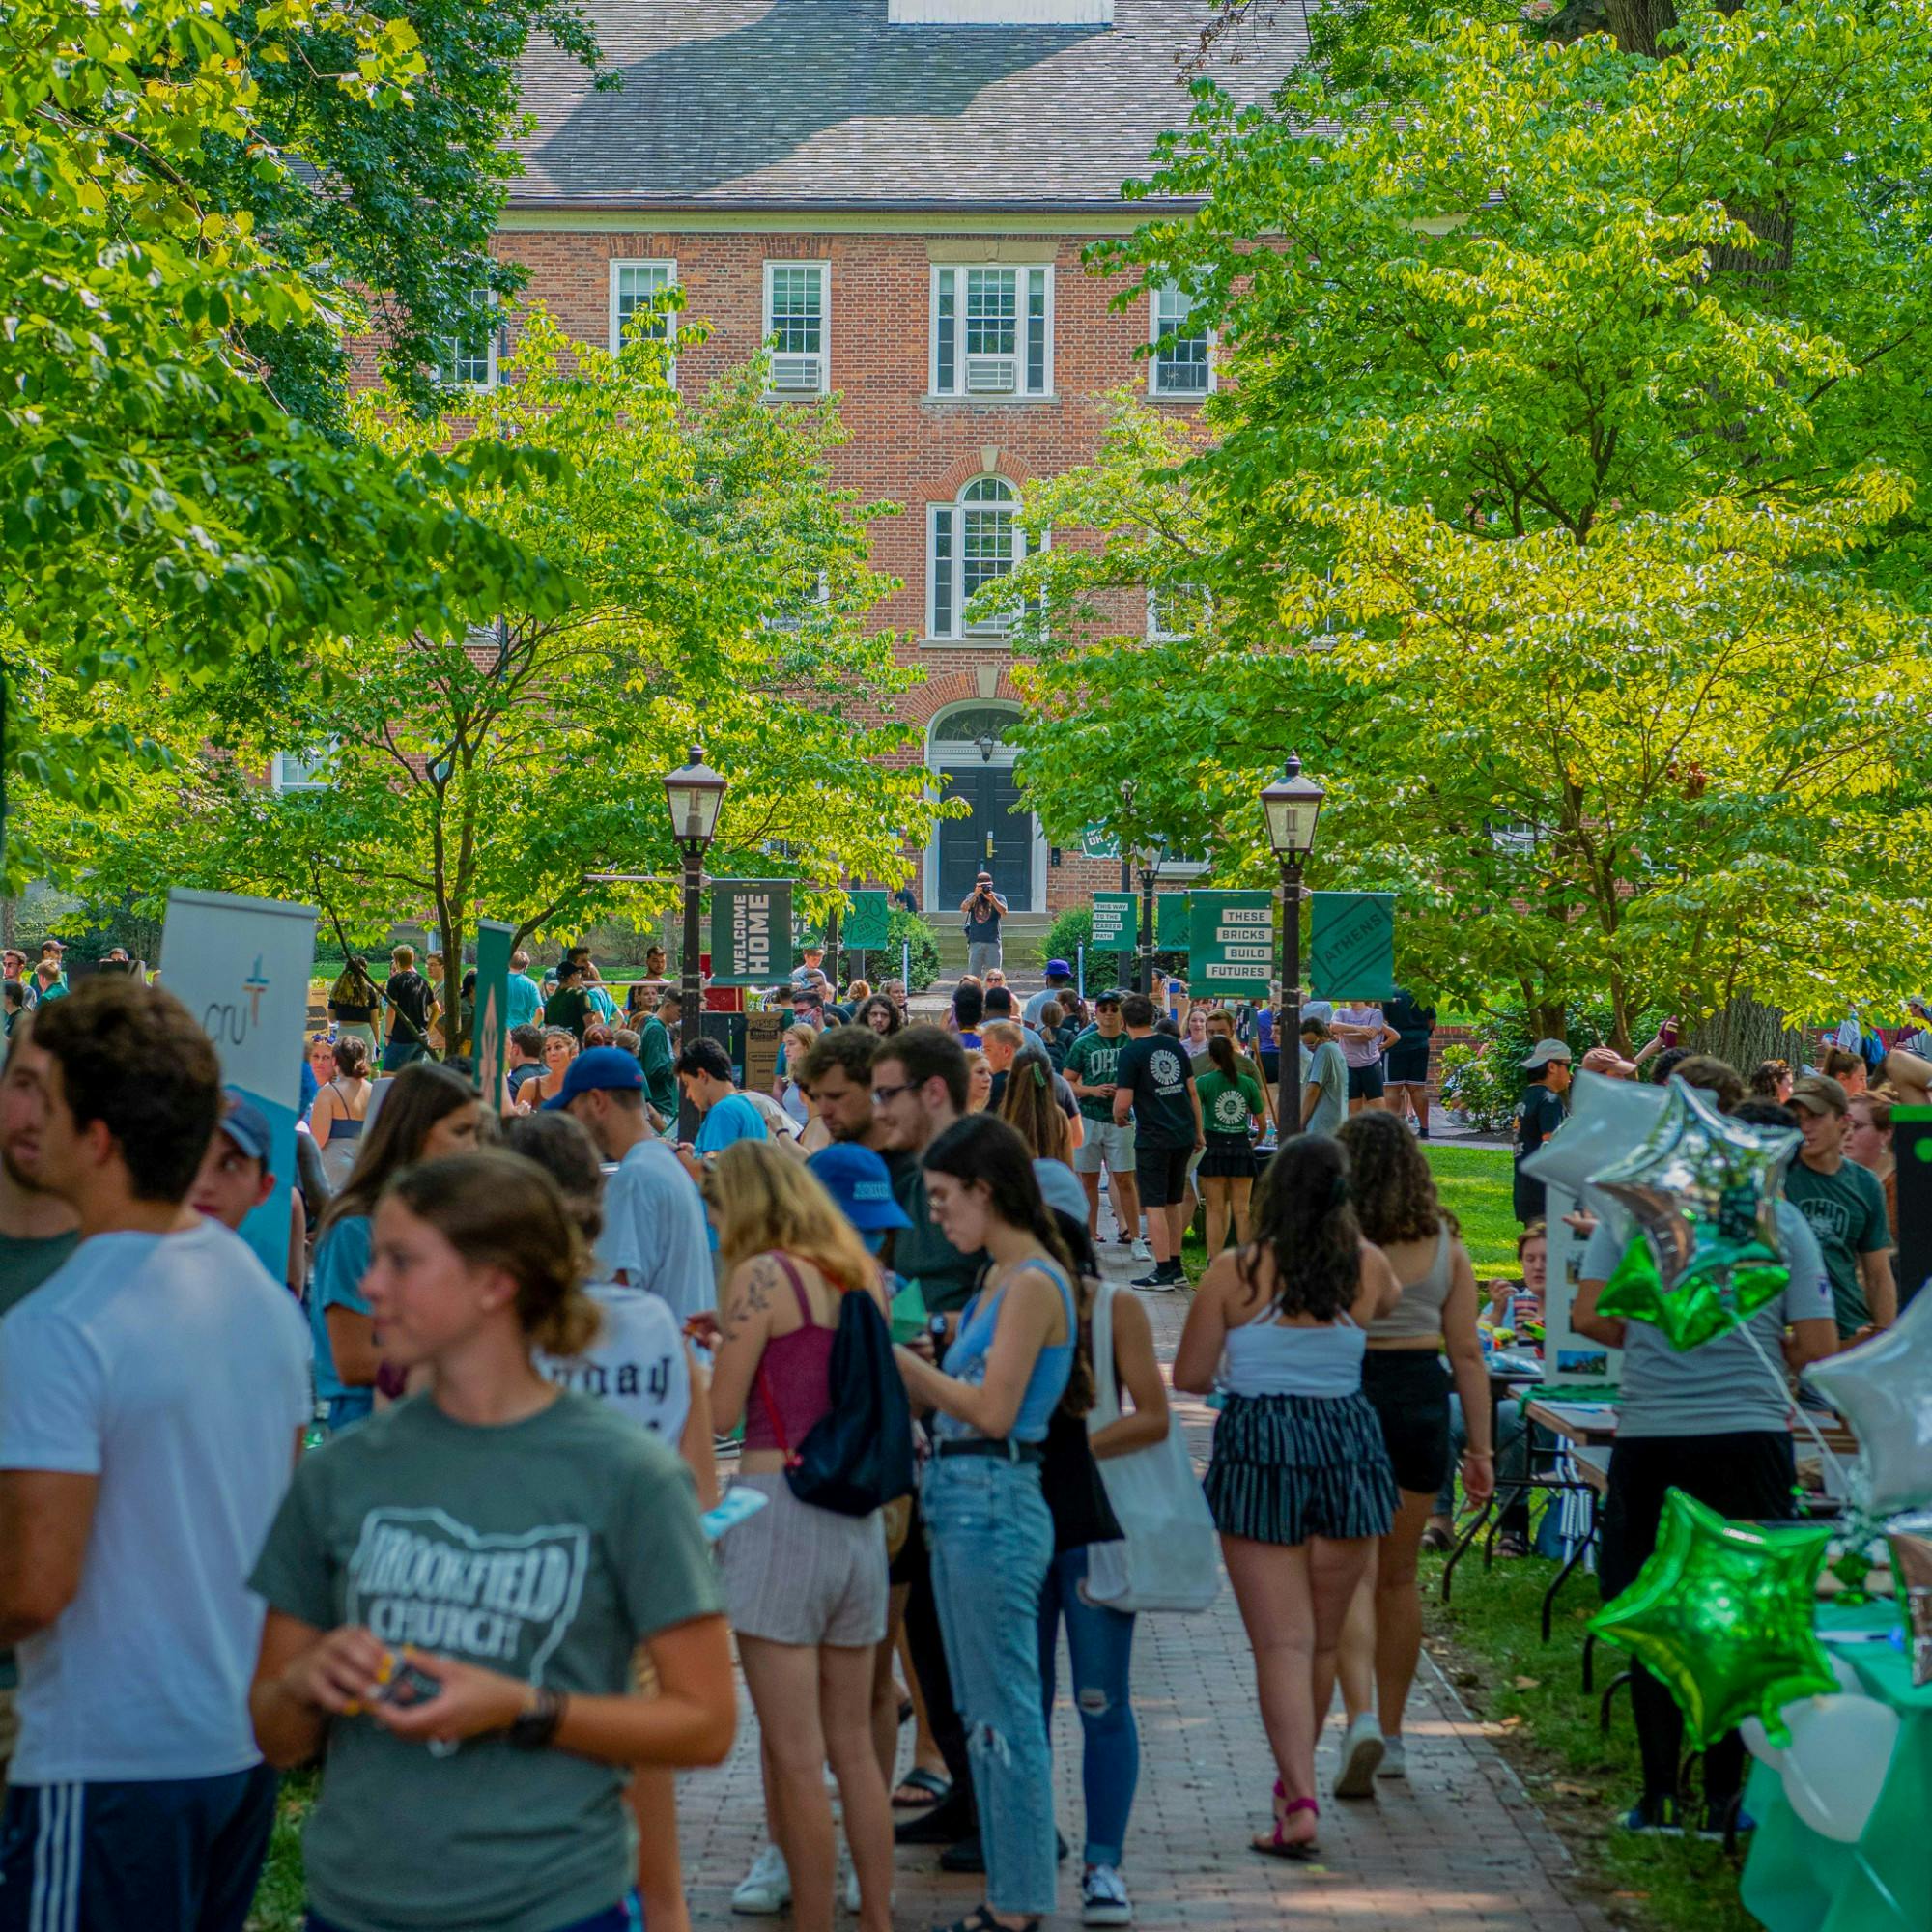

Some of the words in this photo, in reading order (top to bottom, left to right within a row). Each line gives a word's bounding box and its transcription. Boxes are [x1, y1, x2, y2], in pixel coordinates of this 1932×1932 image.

[733, 895, 746, 975] WELCOME
[748, 894, 769, 974] HOME
[1222, 930, 1265, 940] BRICKS
[1228, 912, 1265, 921] THESE
[1231, 949, 1264, 958] BUILD
[1325, 913, 1383, 964] ATHENS
[1211, 967, 1264, 977] FUTURES
[203, 1003, 248, 1045] cru
[369, 1597, 524, 1663] CHURCH
